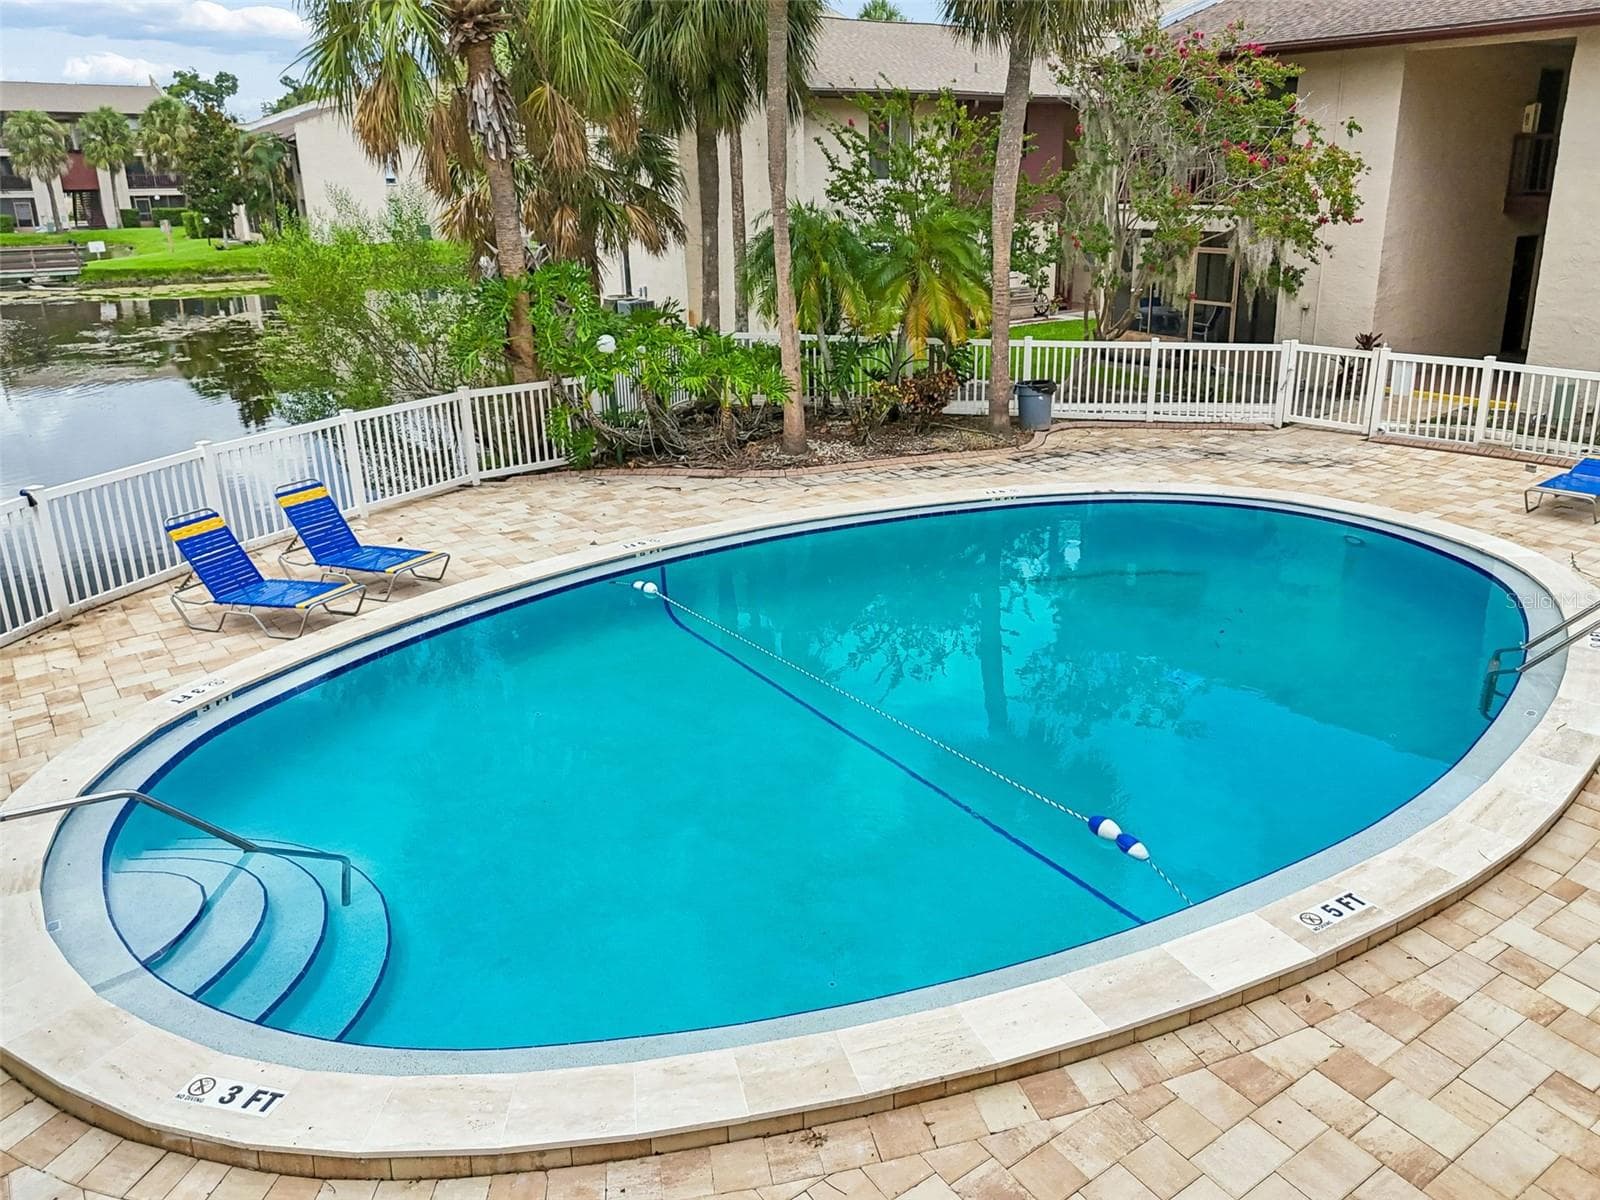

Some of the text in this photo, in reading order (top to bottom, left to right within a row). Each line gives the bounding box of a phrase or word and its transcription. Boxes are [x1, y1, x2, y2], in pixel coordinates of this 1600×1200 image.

[1320, 892, 1366, 917] 5 FT
[218, 1085, 285, 1113] 3 FT
